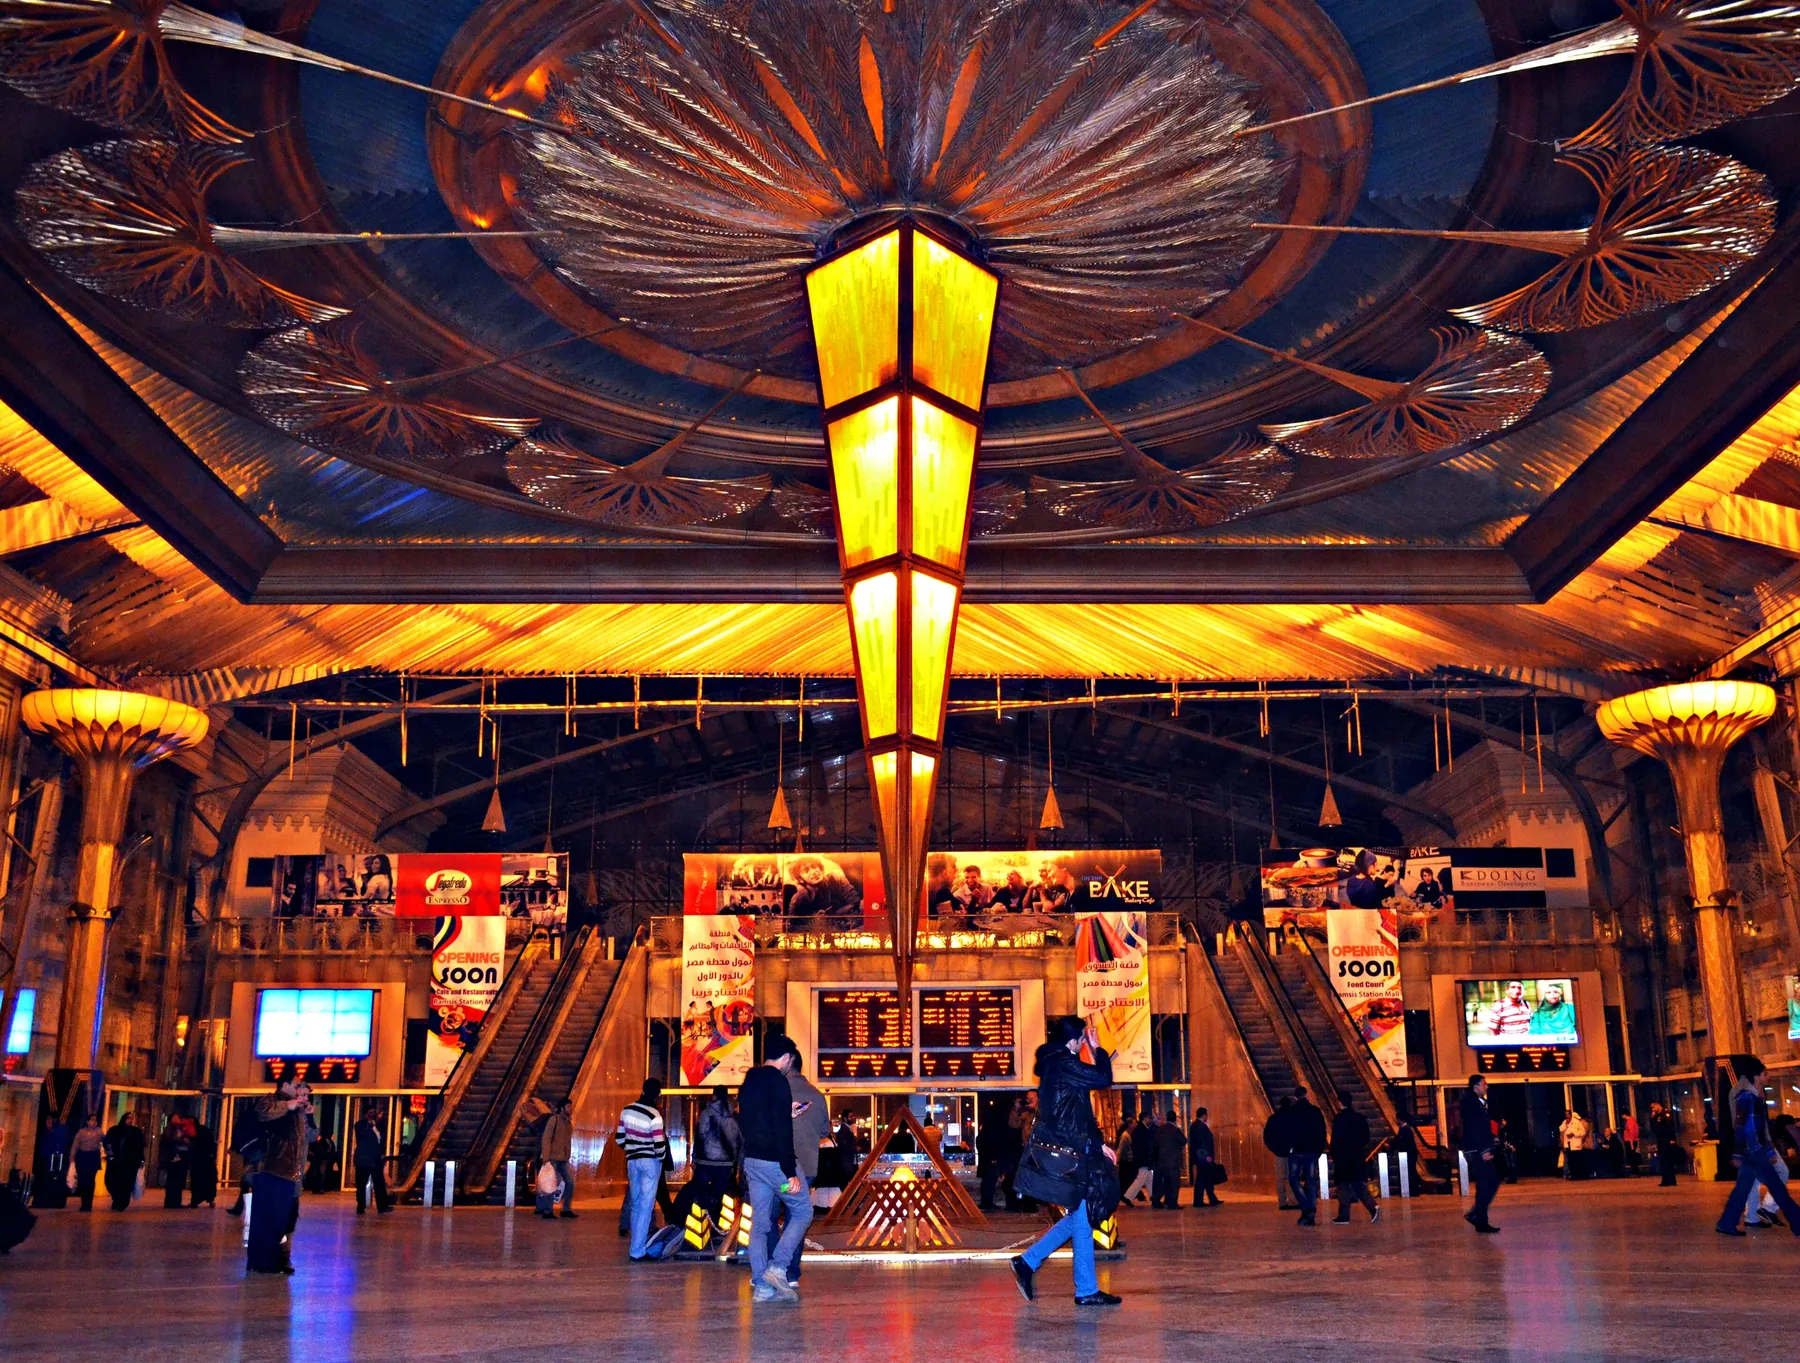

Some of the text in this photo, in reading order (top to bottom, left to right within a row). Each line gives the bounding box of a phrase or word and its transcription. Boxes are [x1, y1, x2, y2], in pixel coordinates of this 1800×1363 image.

[1089, 876, 1150, 898] BAKE
[1331, 945, 1397, 957] OPENING
[436, 952, 500, 964] OPENING
[706, 958, 730, 966] محطة
[686, 959, 704, 968] مصر
[1083, 980, 1100, 988] مصر
[1100, 979, 1123, 987] محطة
[1359, 990, 1384, 998] Station
[1385, 990, 1400, 998] Mall
